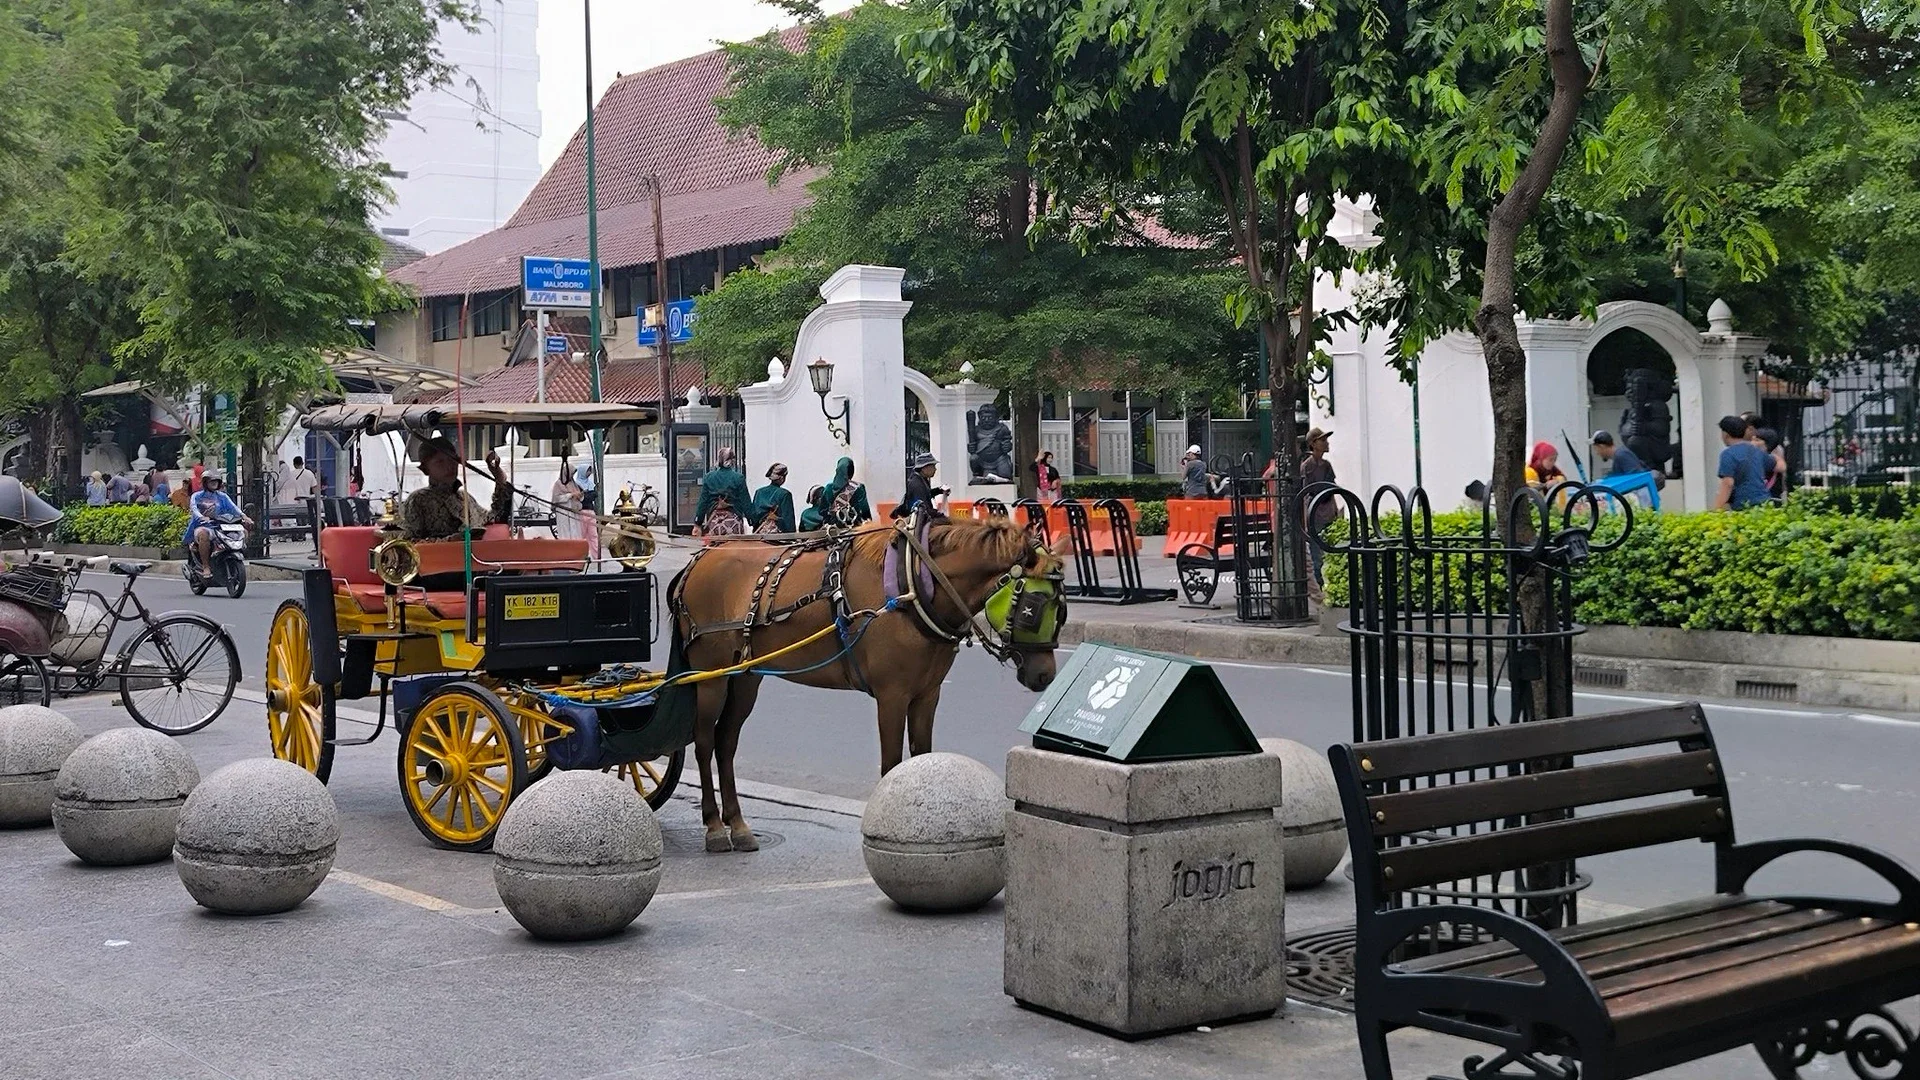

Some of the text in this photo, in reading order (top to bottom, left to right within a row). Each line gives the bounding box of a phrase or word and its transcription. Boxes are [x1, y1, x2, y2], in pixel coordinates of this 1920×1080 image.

[532, 266, 554, 275] BANK
[563, 267, 580, 276] BPD
[542, 280, 584, 290] MALIOBORO
[530, 292, 557, 303] ATM
[506, 597, 519, 607] YK
[523, 596, 537, 607] 182
[1162, 852, 1256, 909] jogja
